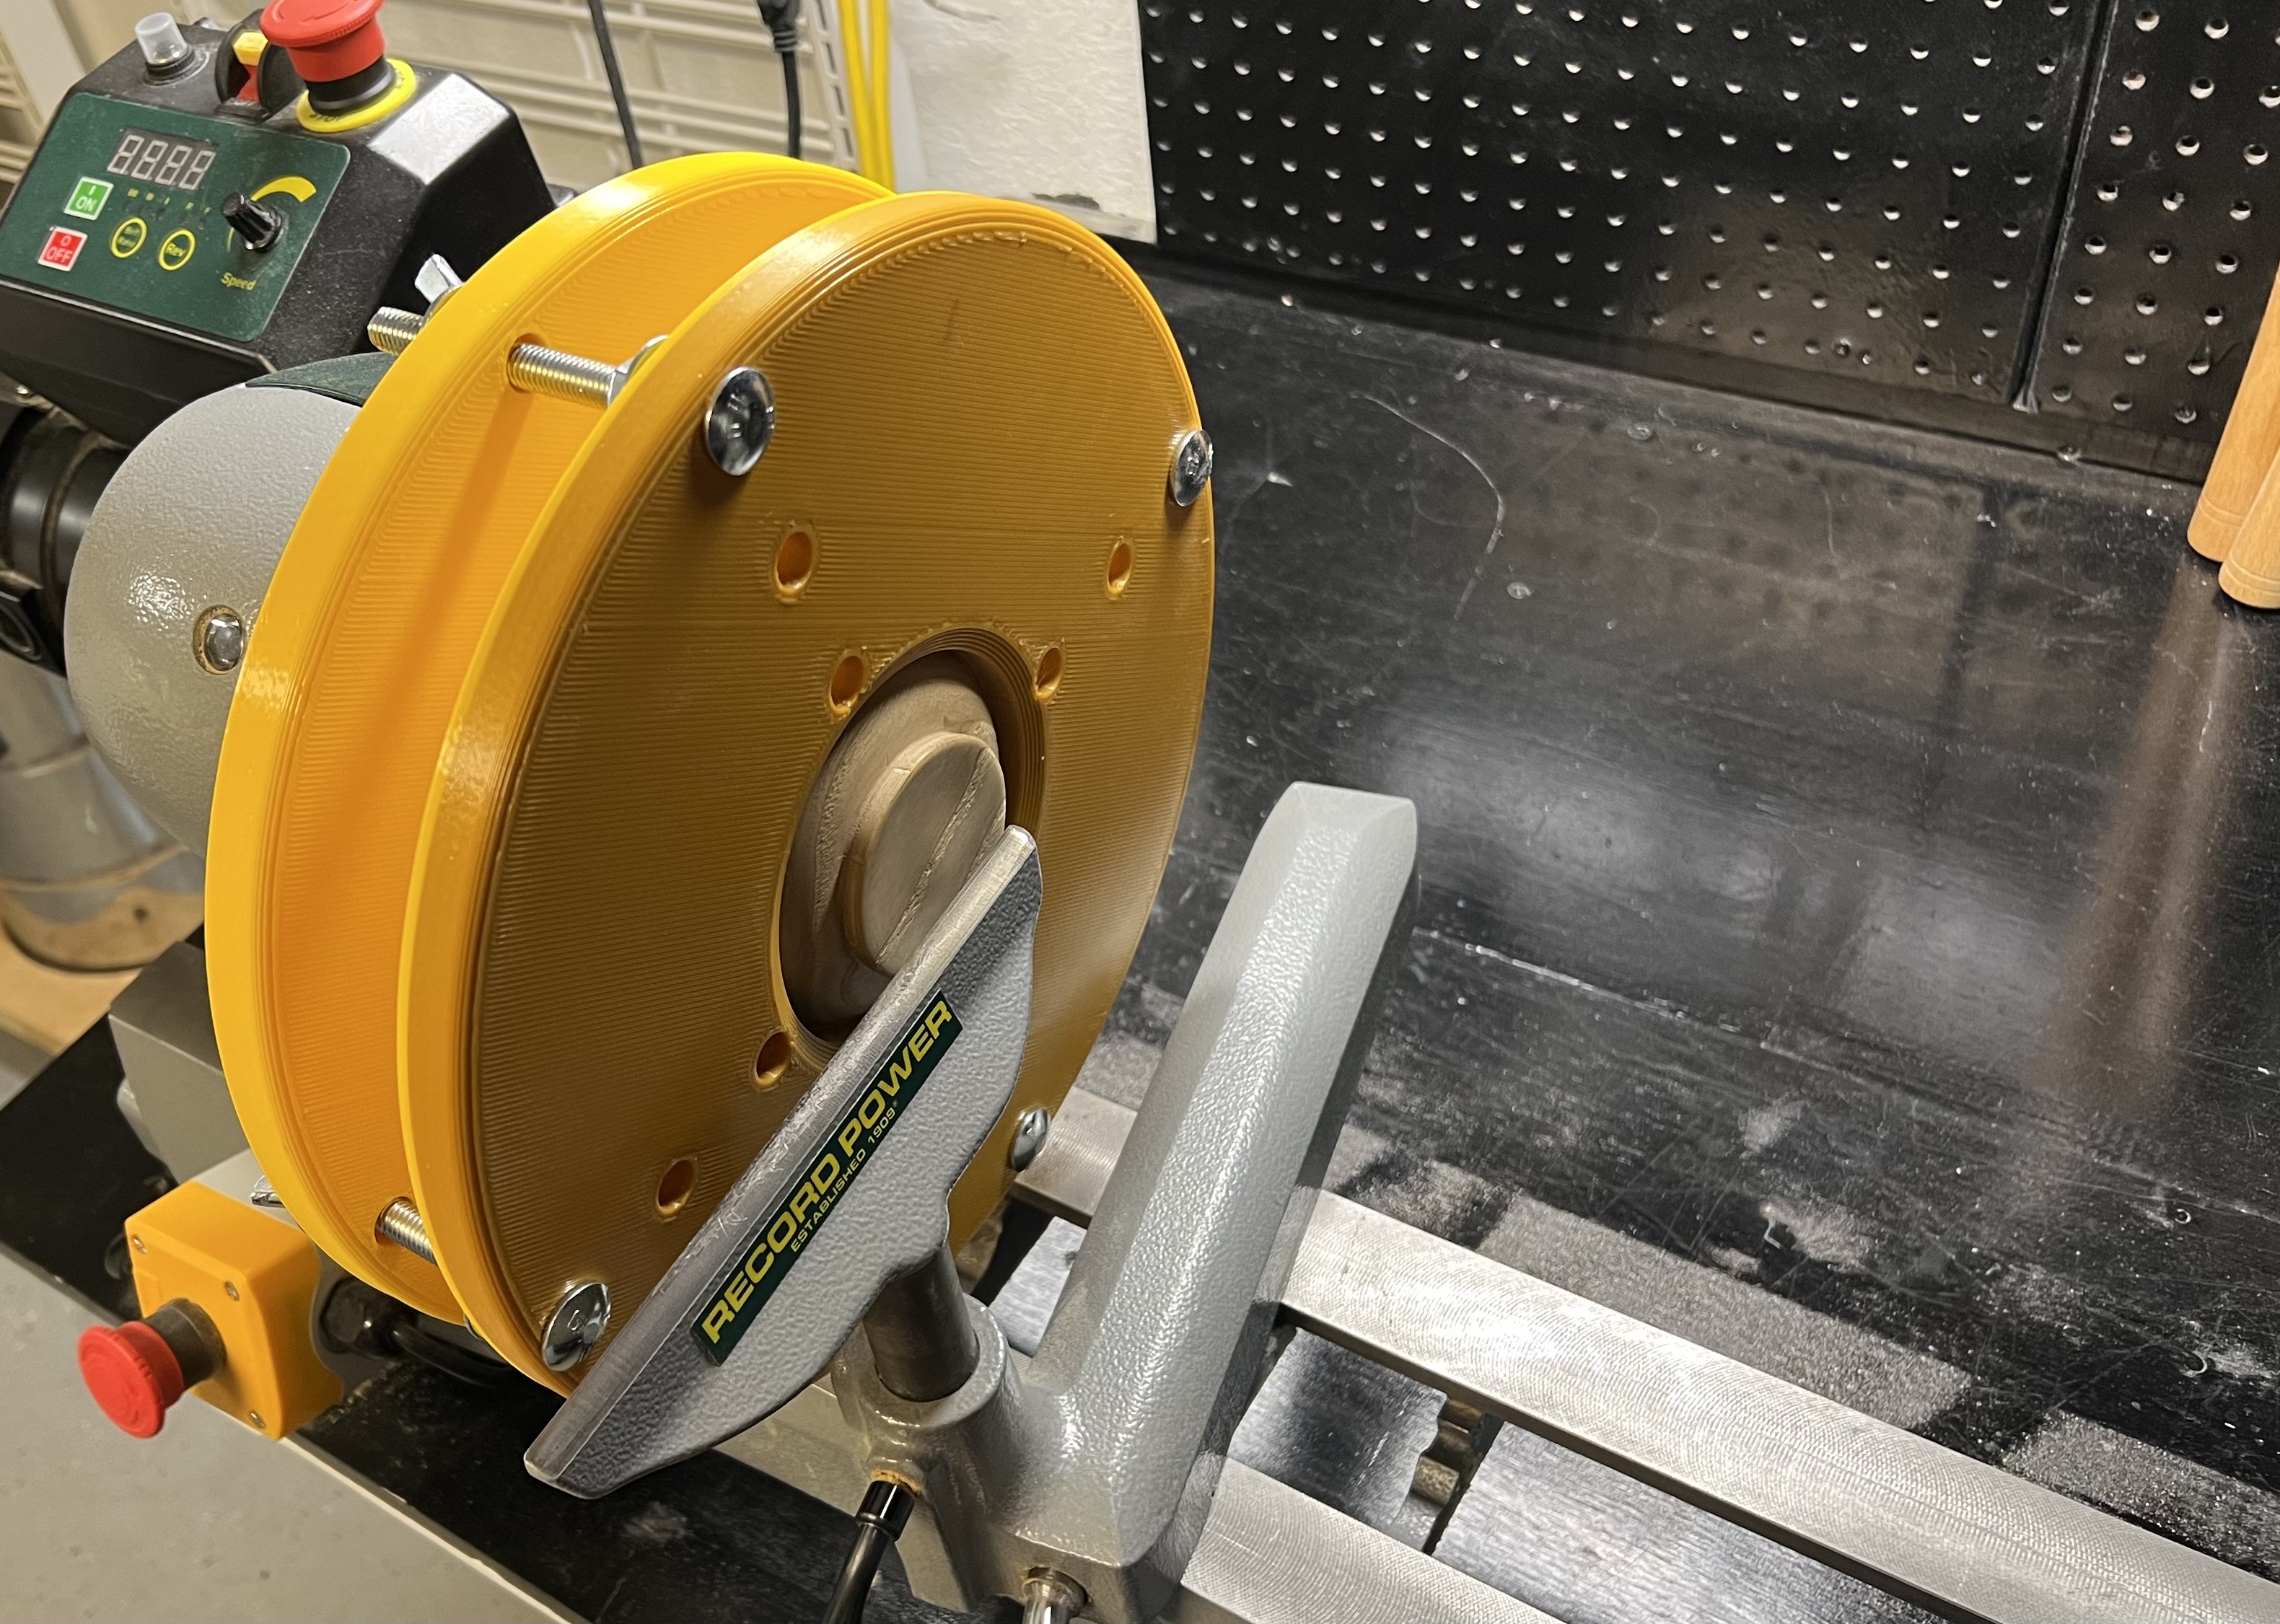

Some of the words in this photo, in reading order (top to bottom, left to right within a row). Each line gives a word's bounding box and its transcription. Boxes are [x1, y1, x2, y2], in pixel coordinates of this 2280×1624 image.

[75, 196, 97, 211] ON
[45, 245, 73, 263] OFF
[221, 272, 256, 290] Speed
[701, 1152, 841, 1343] RECORD
[838, 1000, 952, 1156] POWER
[790, 1148, 867, 1252] ESTABLISHED
